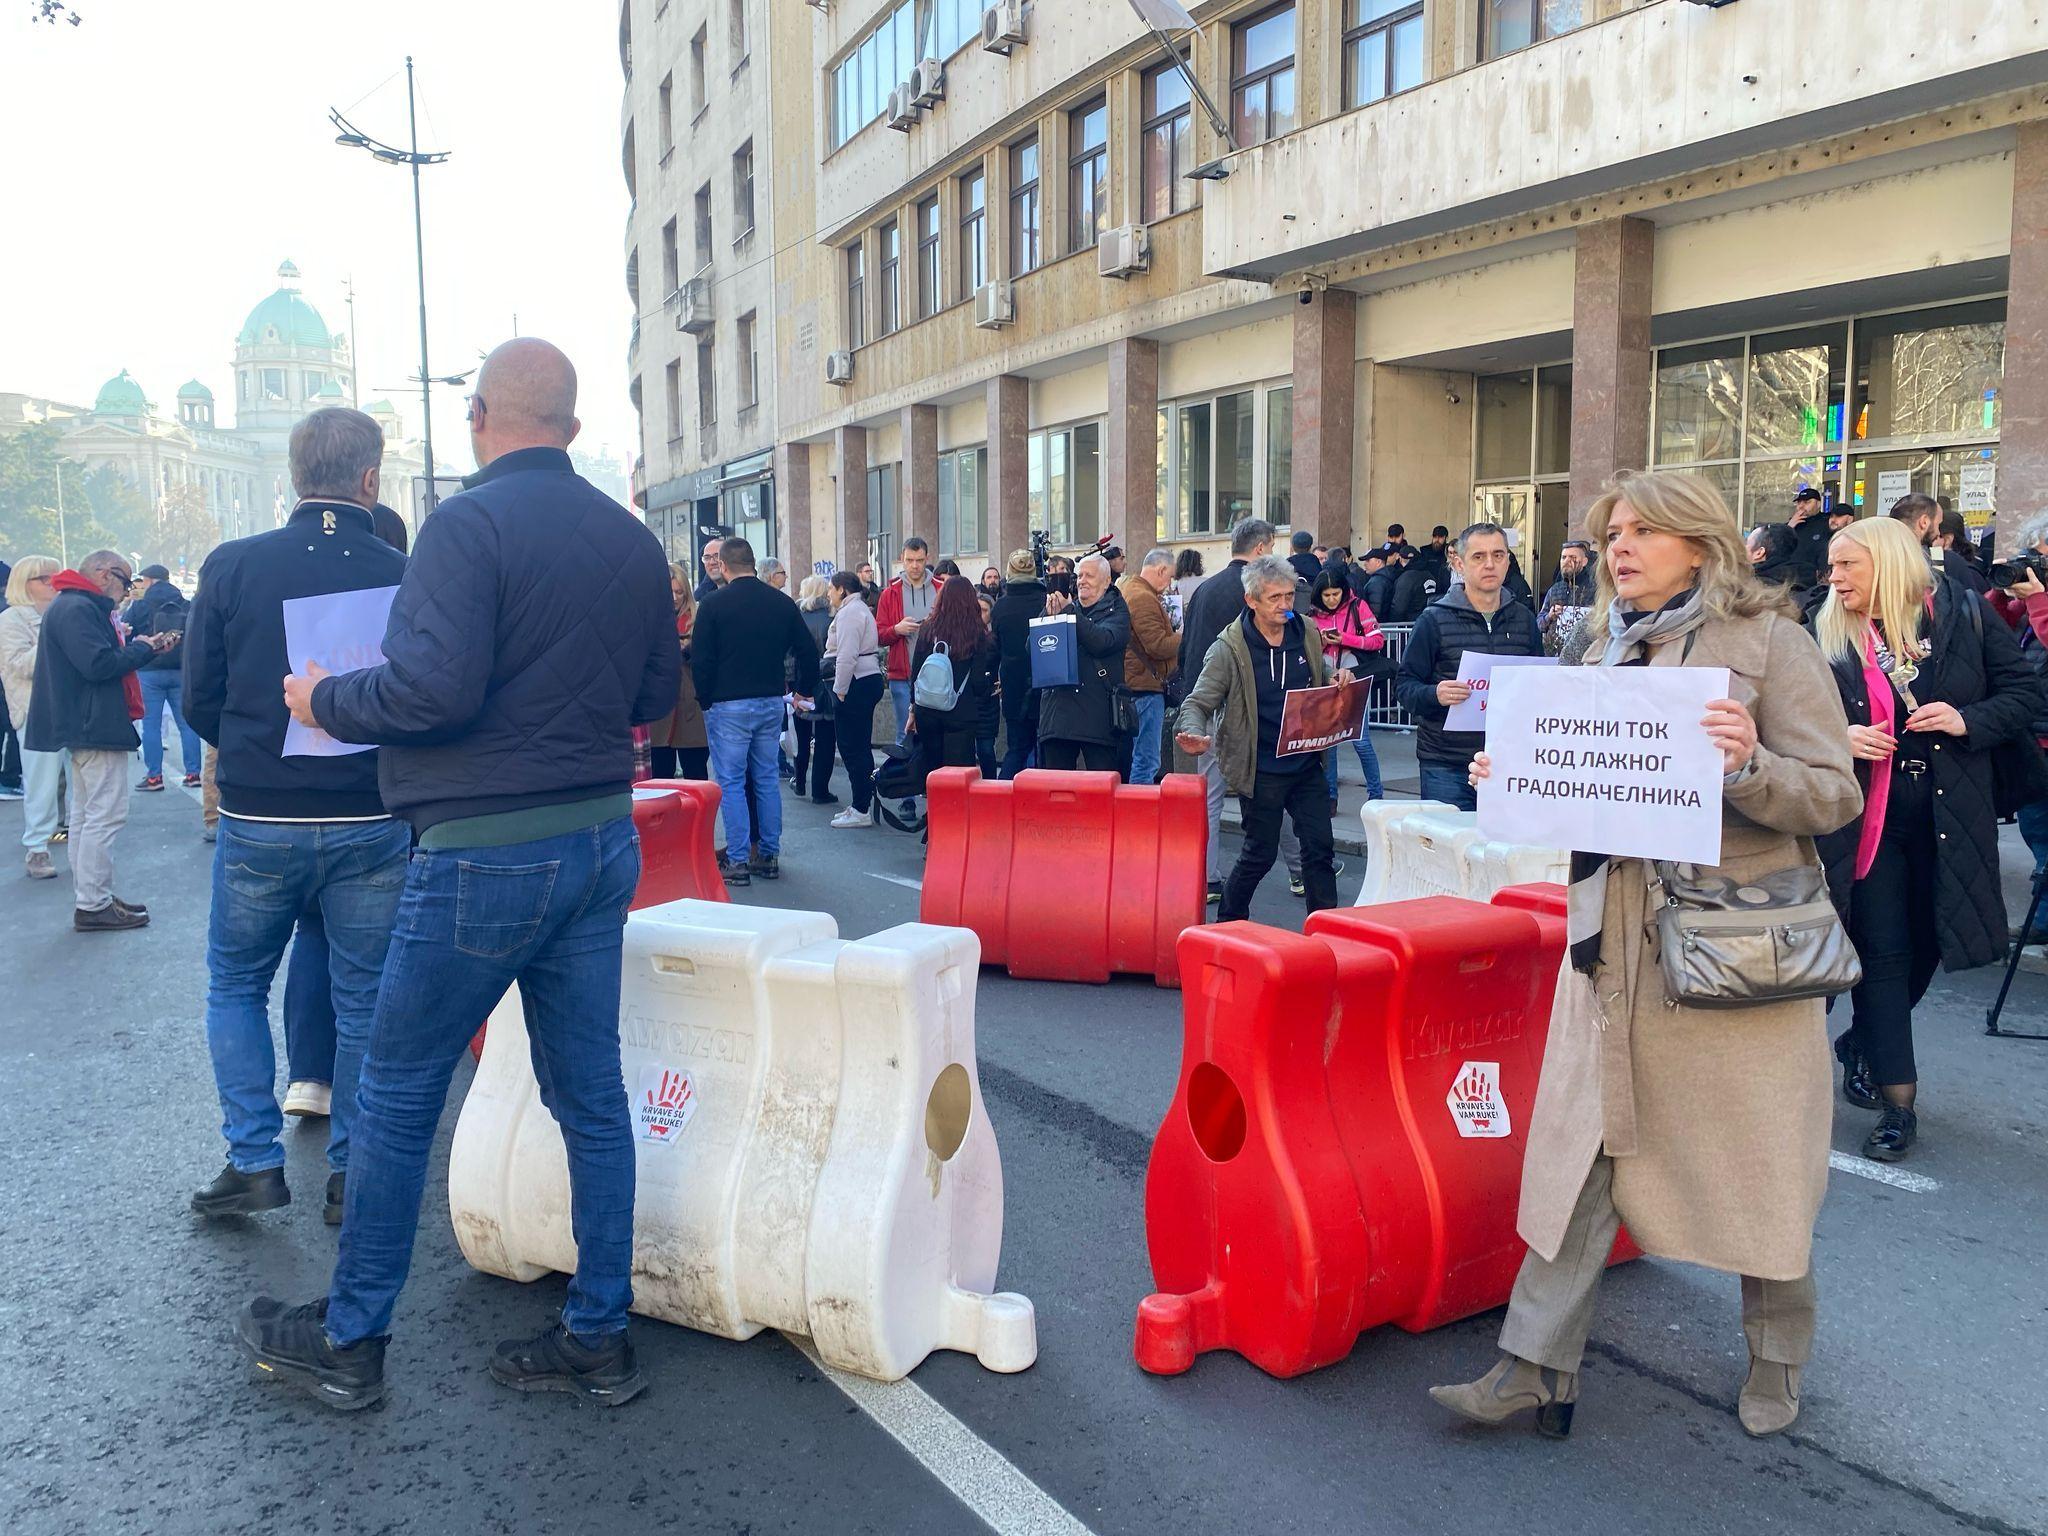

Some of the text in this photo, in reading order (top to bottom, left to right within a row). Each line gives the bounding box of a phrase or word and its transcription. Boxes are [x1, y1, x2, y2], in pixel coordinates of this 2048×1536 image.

[1534, 716, 1669, 740] КРУЖНИ ТОК
[1534, 747, 1672, 773] КОД ЛАЖНОГ
[1506, 776, 1702, 808] ГРАДОНАЧЕЛНИКА
[642, 1105, 685, 1119] KRVAVE SU
[1455, 1101, 1496, 1110] KRVAVE SU
[641, 1114, 683, 1128] VAM RUKE!
[1458, 1110, 1500, 1120] VAM RUKE!
